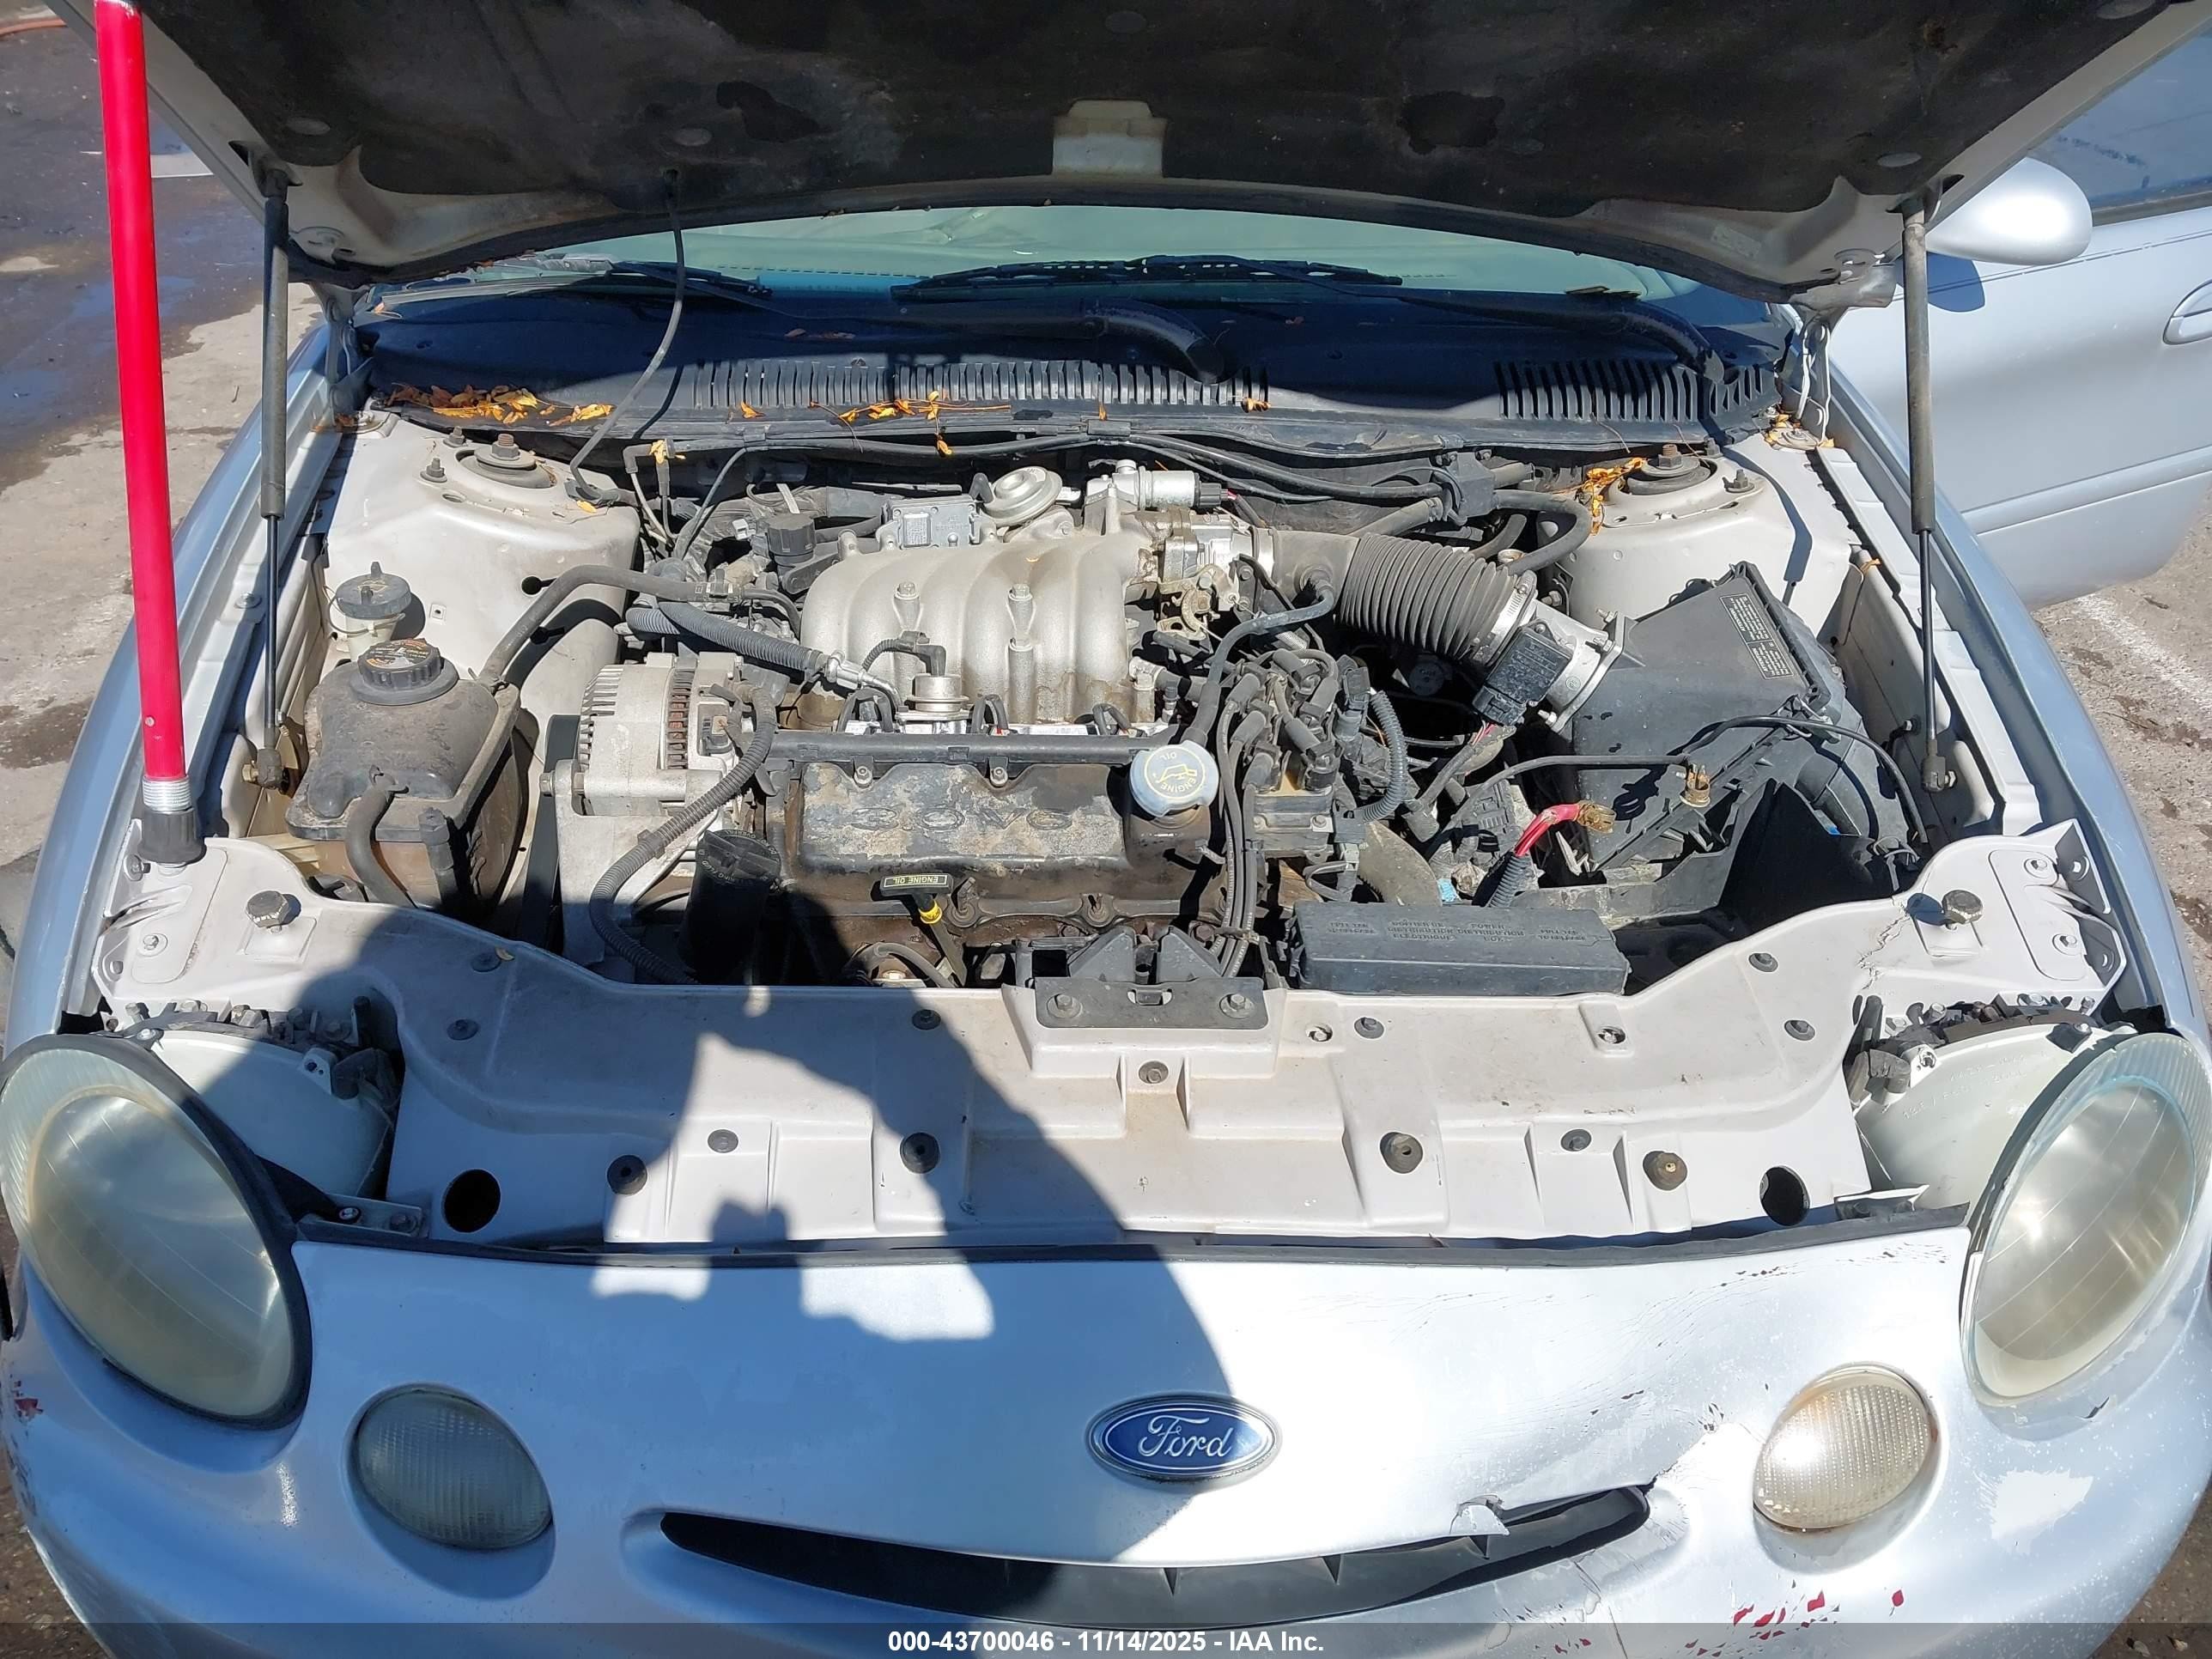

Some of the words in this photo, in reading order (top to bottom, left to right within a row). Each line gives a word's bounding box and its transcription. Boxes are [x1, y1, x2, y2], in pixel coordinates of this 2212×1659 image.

[1159, 751, 1177, 761] OIL
[1160, 777, 1197, 793] ENGINE
[1138, 1414, 1234, 1457] Ford
